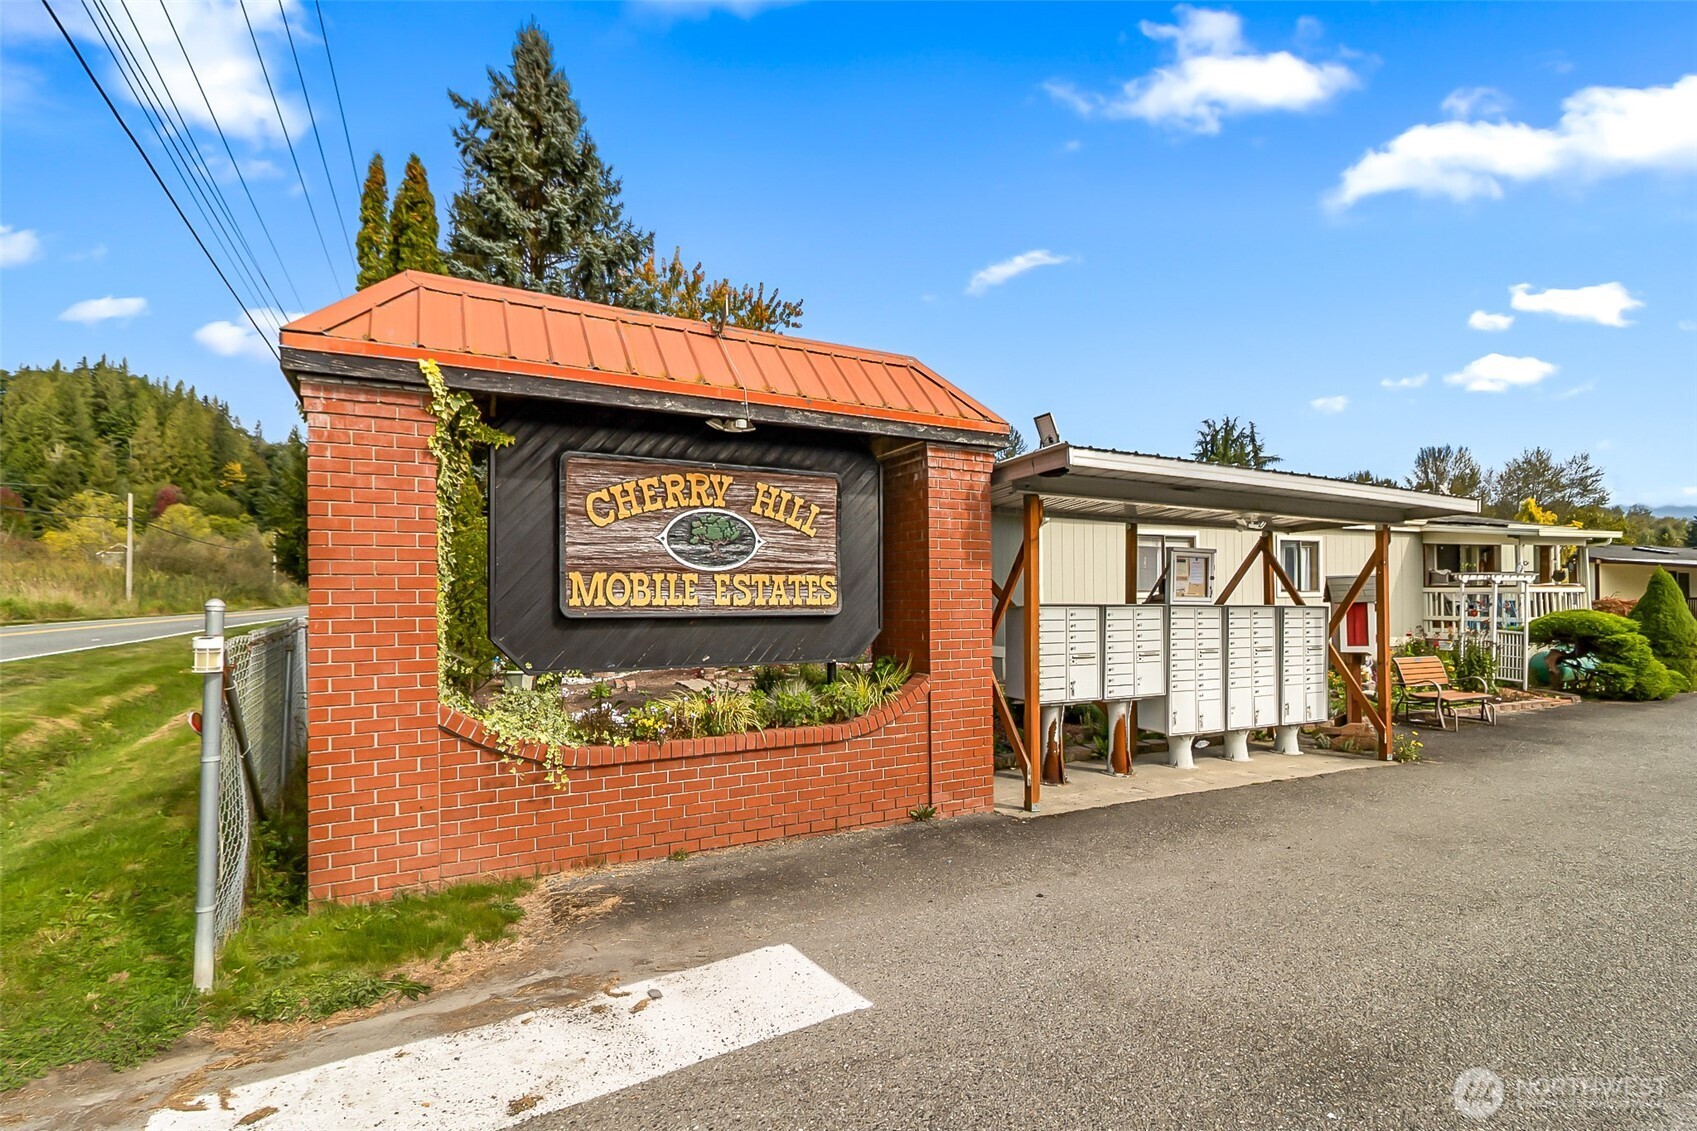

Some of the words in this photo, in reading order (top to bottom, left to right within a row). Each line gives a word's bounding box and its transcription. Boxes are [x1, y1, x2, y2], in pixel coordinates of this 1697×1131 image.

[586, 472, 734, 527] CHERRY
[750, 481, 820, 538] HILL
[568, 571, 699, 607] MOBILE
[713, 574, 838, 606] ESTATES
